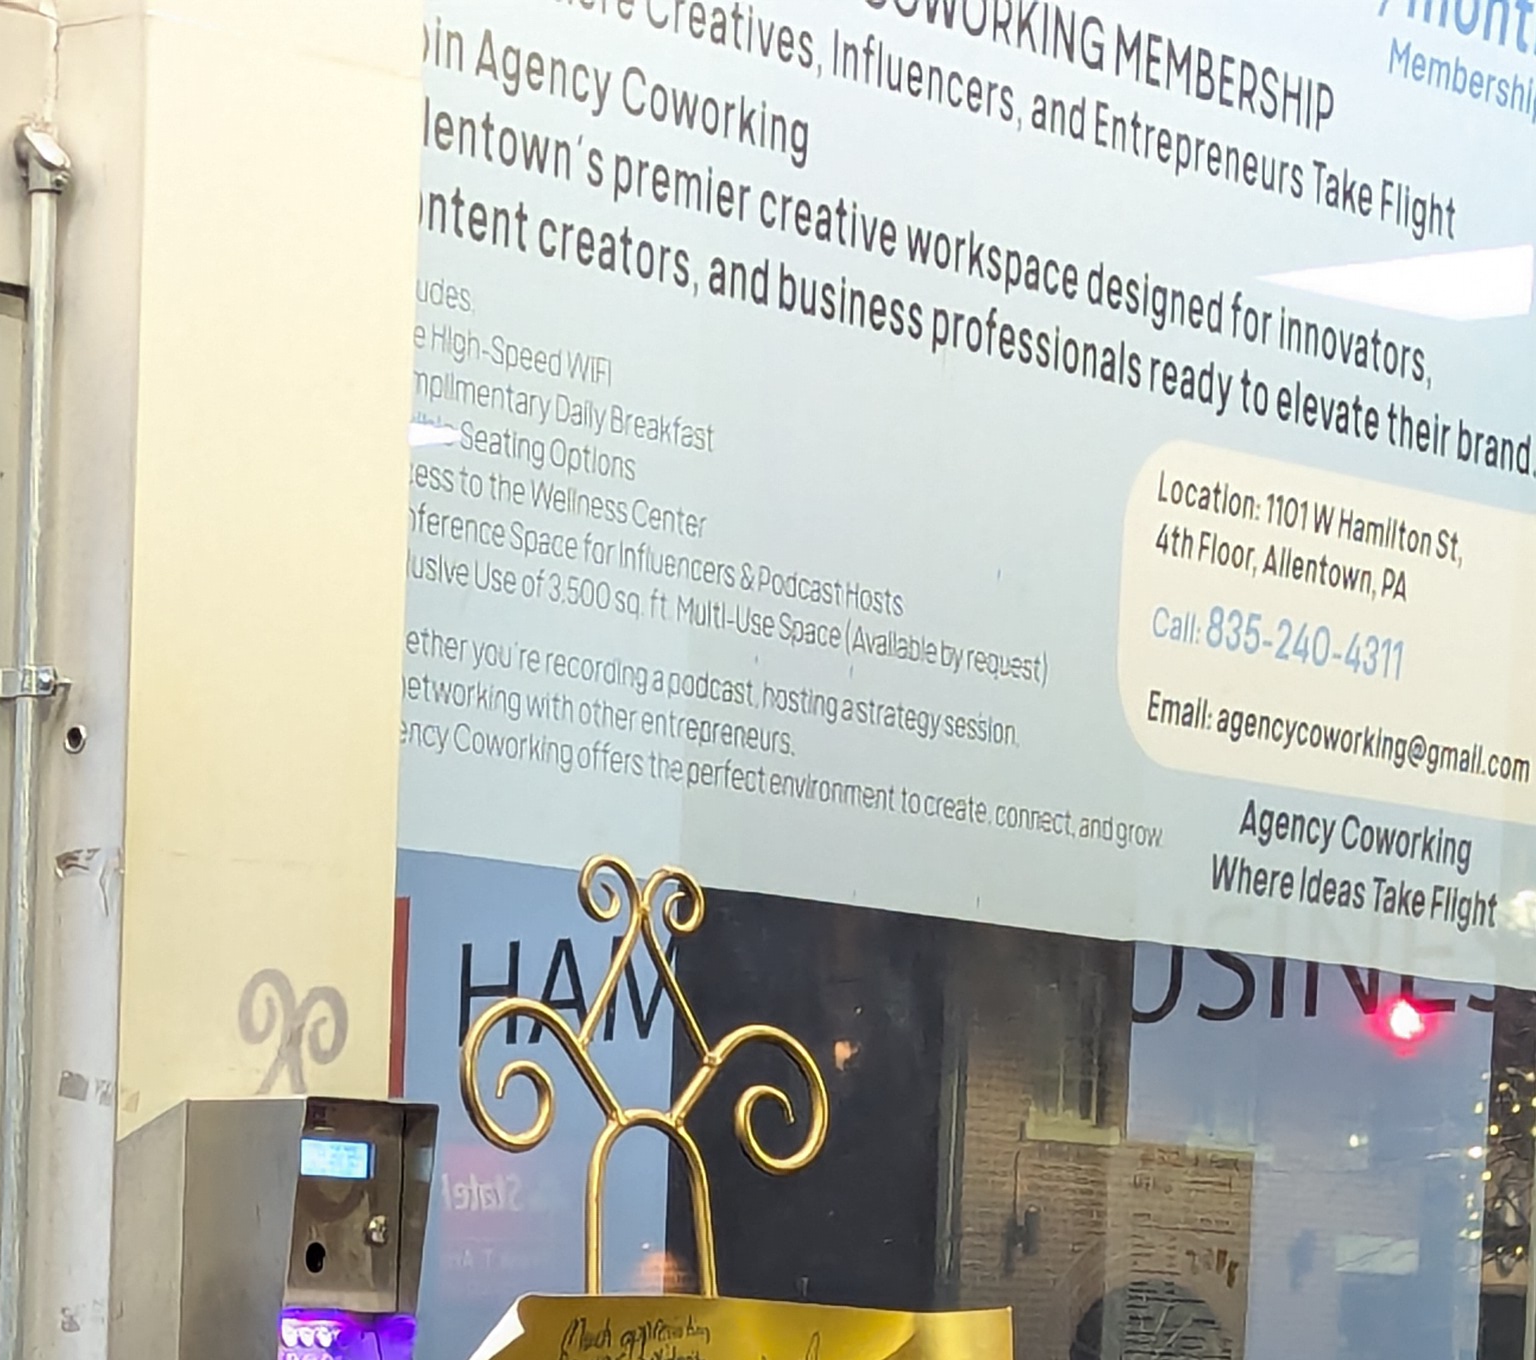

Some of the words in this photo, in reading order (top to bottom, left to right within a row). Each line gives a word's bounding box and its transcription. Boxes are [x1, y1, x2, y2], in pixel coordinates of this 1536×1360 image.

[475, 28, 611, 117] Agency
[622, 66, 809, 169] Coworking
[868, 0, 1105, 72] WORKING
[1115, 23, 1335, 132] MEMBERSHIP
[646, 0, 823, 78] Creatives,
[832, 28, 1022, 132] Influencers,
[1031, 93, 1085, 141] and
[1094, 100, 1304, 199] Entrepreneurs
[1313, 159, 1373, 217] Take
[1380, 178, 1456, 241] Flight
[613, 153, 751, 222] premier
[760, 187, 898, 258] creative
[907, 223, 1078, 301] workspace
[1087, 261, 1223, 333] designed
[1231, 291, 1272, 345] for
[1279, 305, 1433, 391] innovators,
[431, 322, 562, 377] High-Speed
[539, 216, 699, 298] creators,
[709, 255, 769, 306] and
[779, 261, 923, 340] business
[932, 306, 1142, 389] professionals
[1149, 354, 1233, 416] ready
[1241, 368, 1269, 416] to
[1277, 380, 1380, 442] elevate
[1388, 402, 1451, 457] their
[460, 420, 546, 470] Seating
[550, 437, 636, 482] Options
[556, 393, 607, 436] Daily
[611, 403, 715, 453] Breakfast
[459, 465, 483, 498] to
[489, 471, 525, 506] the
[531, 478, 628, 524] Wellness
[632, 498, 708, 539] Center
[1156, 469, 1261, 522] Location:
[1266, 492, 1309, 532] 1101
[1313, 504, 1335, 536] W
[1337, 508, 1432, 557] Hamilton
[1435, 528, 1463, 569] St,
[510, 520, 578, 560] Space
[583, 531, 616, 566] for
[619, 539, 736, 589] Influencers
[740, 561, 756, 591] &
[758, 564, 843, 606] Podcast
[845, 582, 905, 618] Hosts
[1155, 523, 1193, 560] 4th
[1197, 531, 1257, 579] Floor,
[1262, 544, 1377, 601] Allentown,
[1381, 567, 1408, 602] PA
[474, 558, 517, 595] Use
[521, 568, 545, 599] of
[677, 594, 776, 640] Multi-Use
[779, 610, 842, 648] Space
[844, 617, 938, 666] (Available
[940, 638, 965, 675] by
[966, 649, 1049, 689] request)
[1151, 606, 1202, 645] Call:
[1205, 604, 1405, 682] 835-240-4311
[405, 627, 469, 663] ether
[545, 651, 648, 695] recording
[652, 668, 665, 694] a
[667, 670, 758, 709] podcast,
[763, 680, 838, 724] hosting
[840, 696, 855, 722] a
[855, 700, 941, 741] strategy
[527, 691, 575, 725] with
[578, 698, 637, 733] other
[641, 710, 796, 758] entrepreneurs.
[453, 722, 573, 773] Coworking
[577, 744, 645, 778] offers
[648, 750, 684, 783] the
[686, 758, 766, 793] perfect
[768, 773, 895, 813] environment
[900, 786, 921, 815] to
[994, 805, 1076, 839] connect,
[1078, 814, 1113, 842] and
[1147, 689, 1213, 731] Email:
[1216, 704, 1531, 783] agencycoworking@gmail.com
[1239, 798, 1336, 855] Agency
[1341, 814, 1472, 875] Coworking
[1211, 853, 1295, 900] Where
[1299, 865, 1365, 911] Ideas
[1372, 876, 1426, 918] Take
[1430, 884, 1498, 933] Flight
